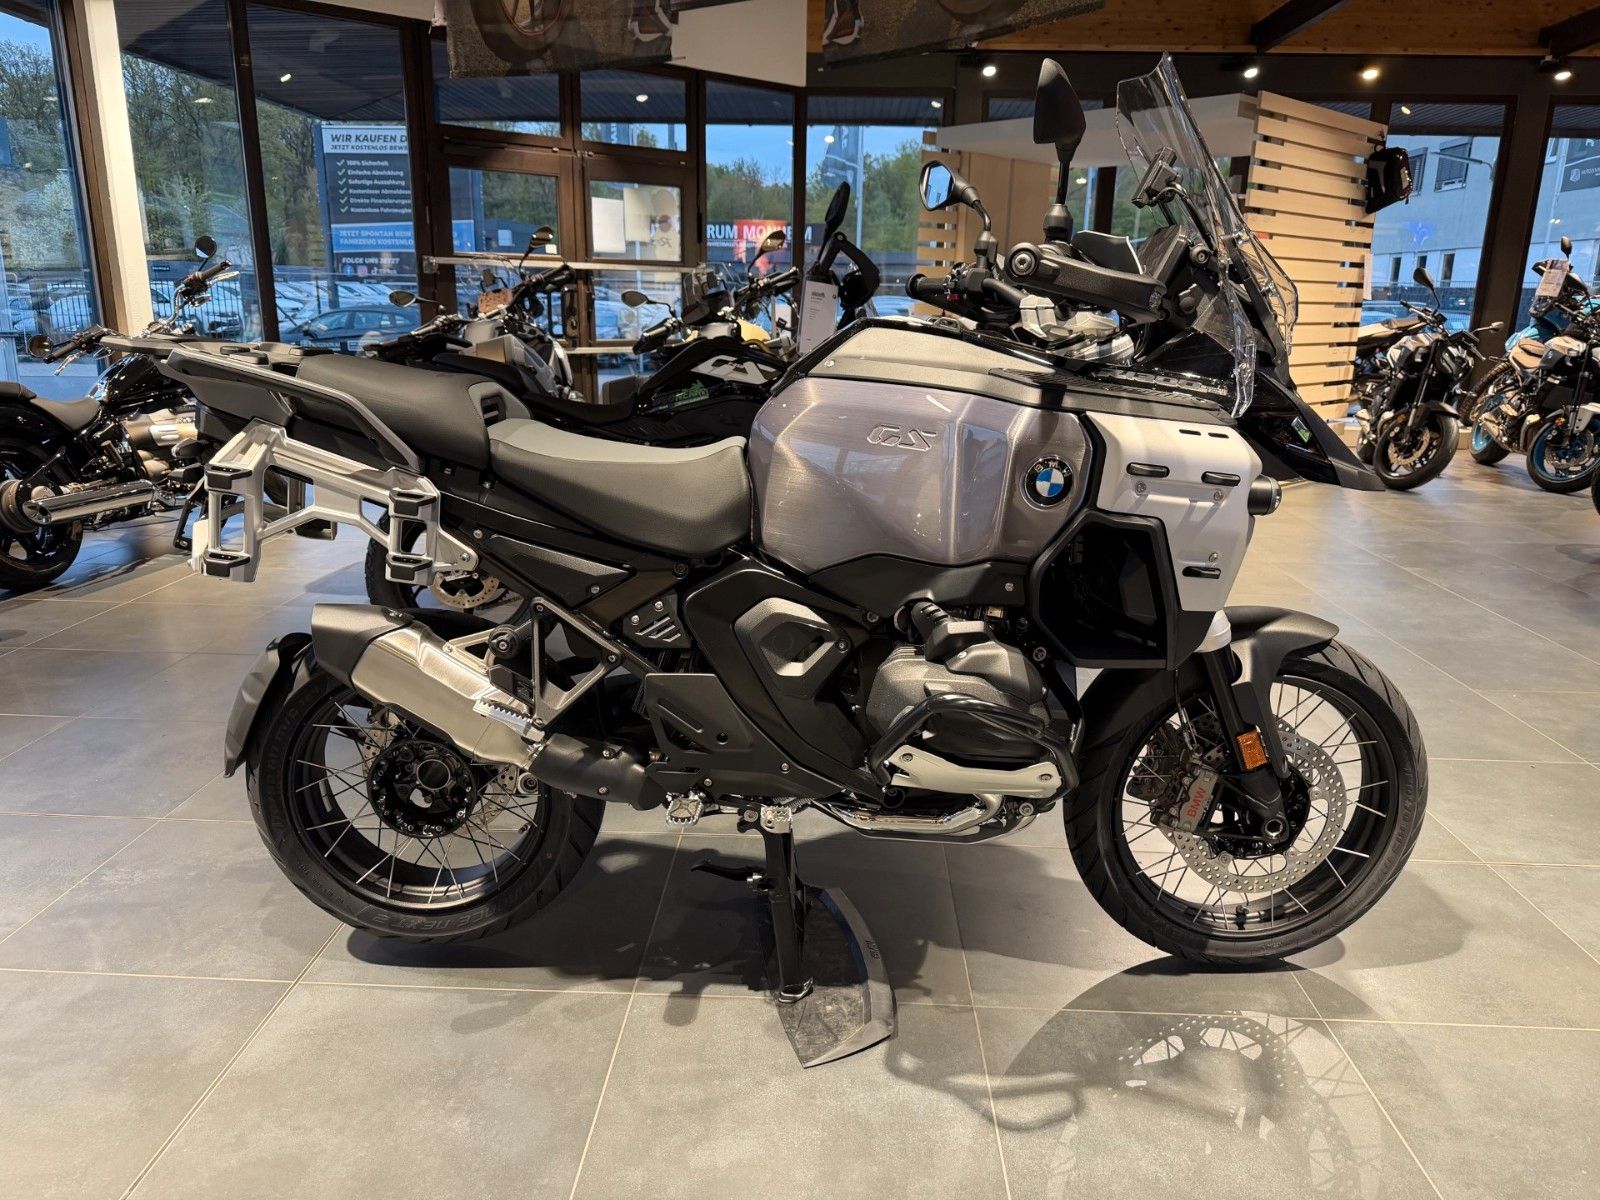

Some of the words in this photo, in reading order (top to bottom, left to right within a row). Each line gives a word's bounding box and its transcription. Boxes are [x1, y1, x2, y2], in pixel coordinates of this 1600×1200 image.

[331, 134, 352, 143] WIR
[355, 134, 397, 143] KAUFEN
[706, 224, 738, 240] RUM
[866, 422, 938, 453] GS
[1186, 786, 1207, 818] BMW
